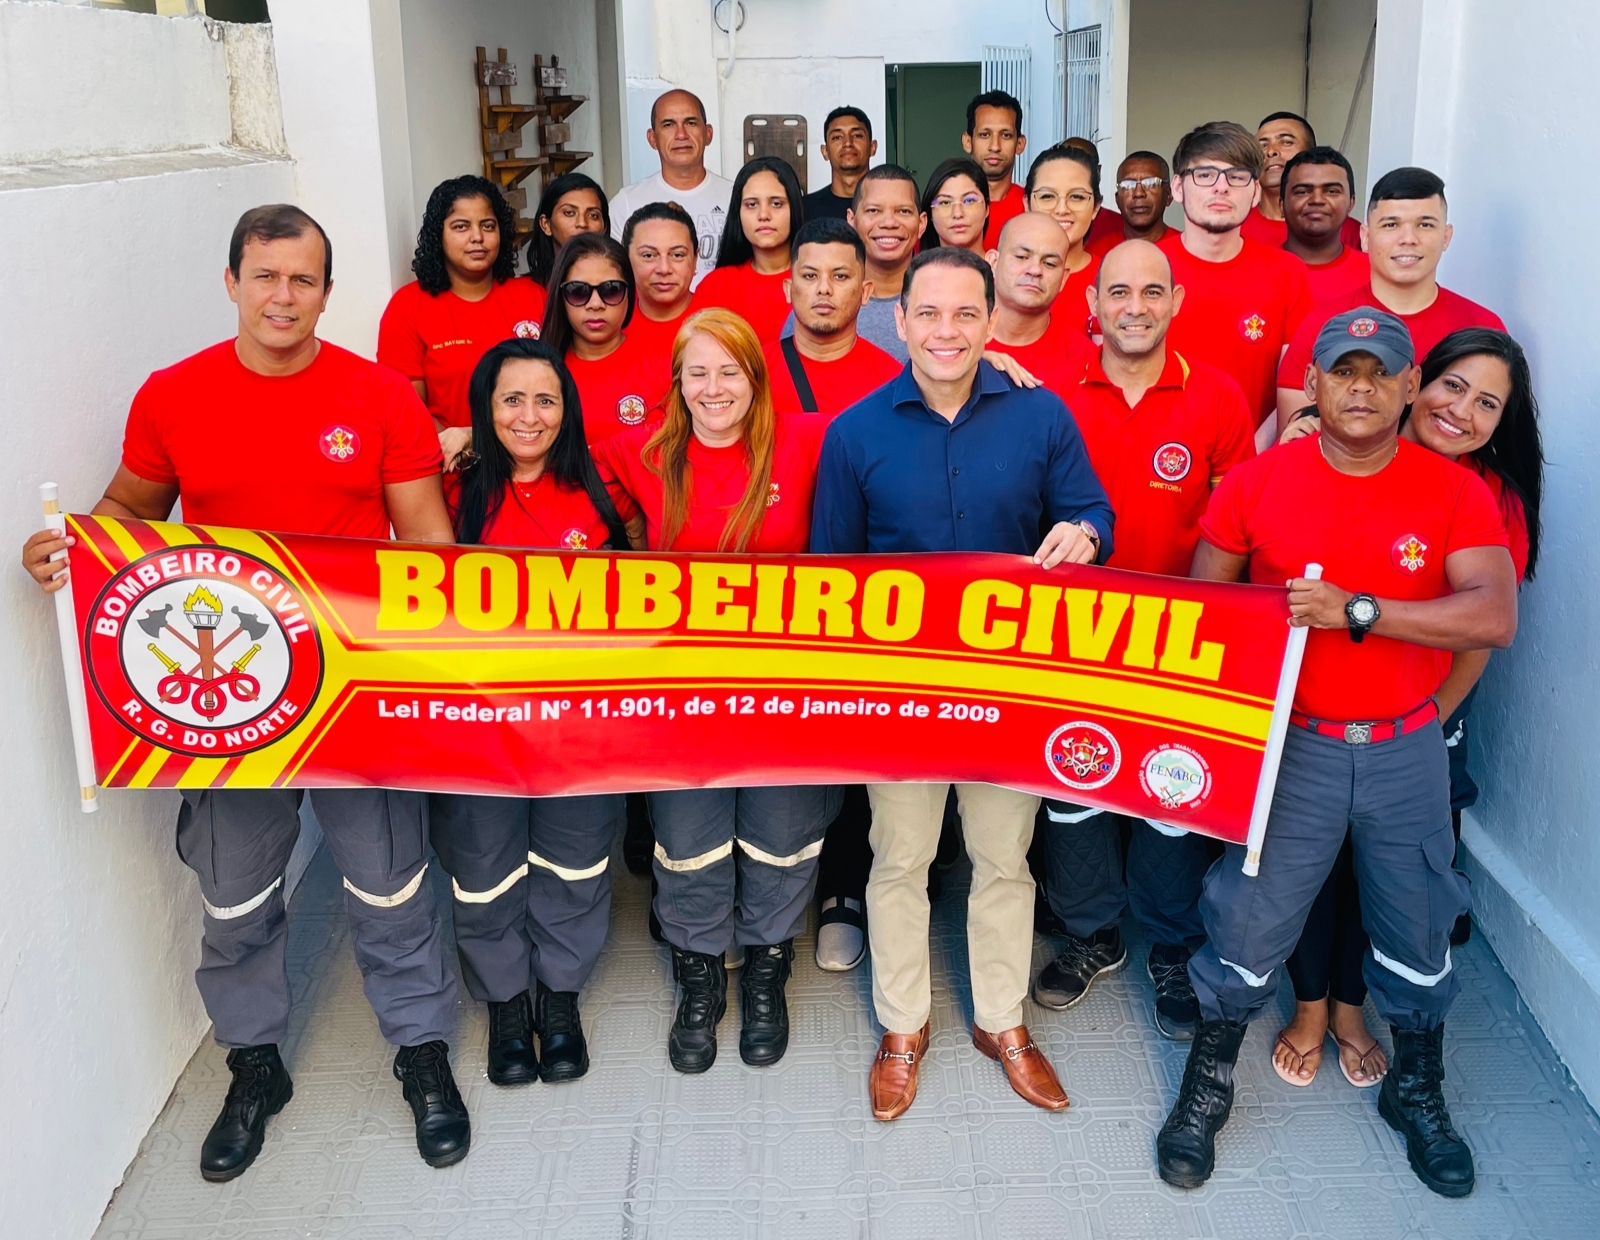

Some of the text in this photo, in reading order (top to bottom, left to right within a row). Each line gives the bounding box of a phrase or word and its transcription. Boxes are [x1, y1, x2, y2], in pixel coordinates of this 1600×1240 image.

[1149, 480, 1182, 493] DIRETORIA
[95, 552, 309, 643] BOMBEIRO CIVIL
[376, 549, 1225, 682] BOMBEIRO CIVIL
[122, 699, 298, 748] R. G. DO NORTE
[378, 696, 1000, 723] Lei Federal Nº 11.901, de 12 de janeiro de 2009
[1150, 763, 1203, 785] FENABCI
